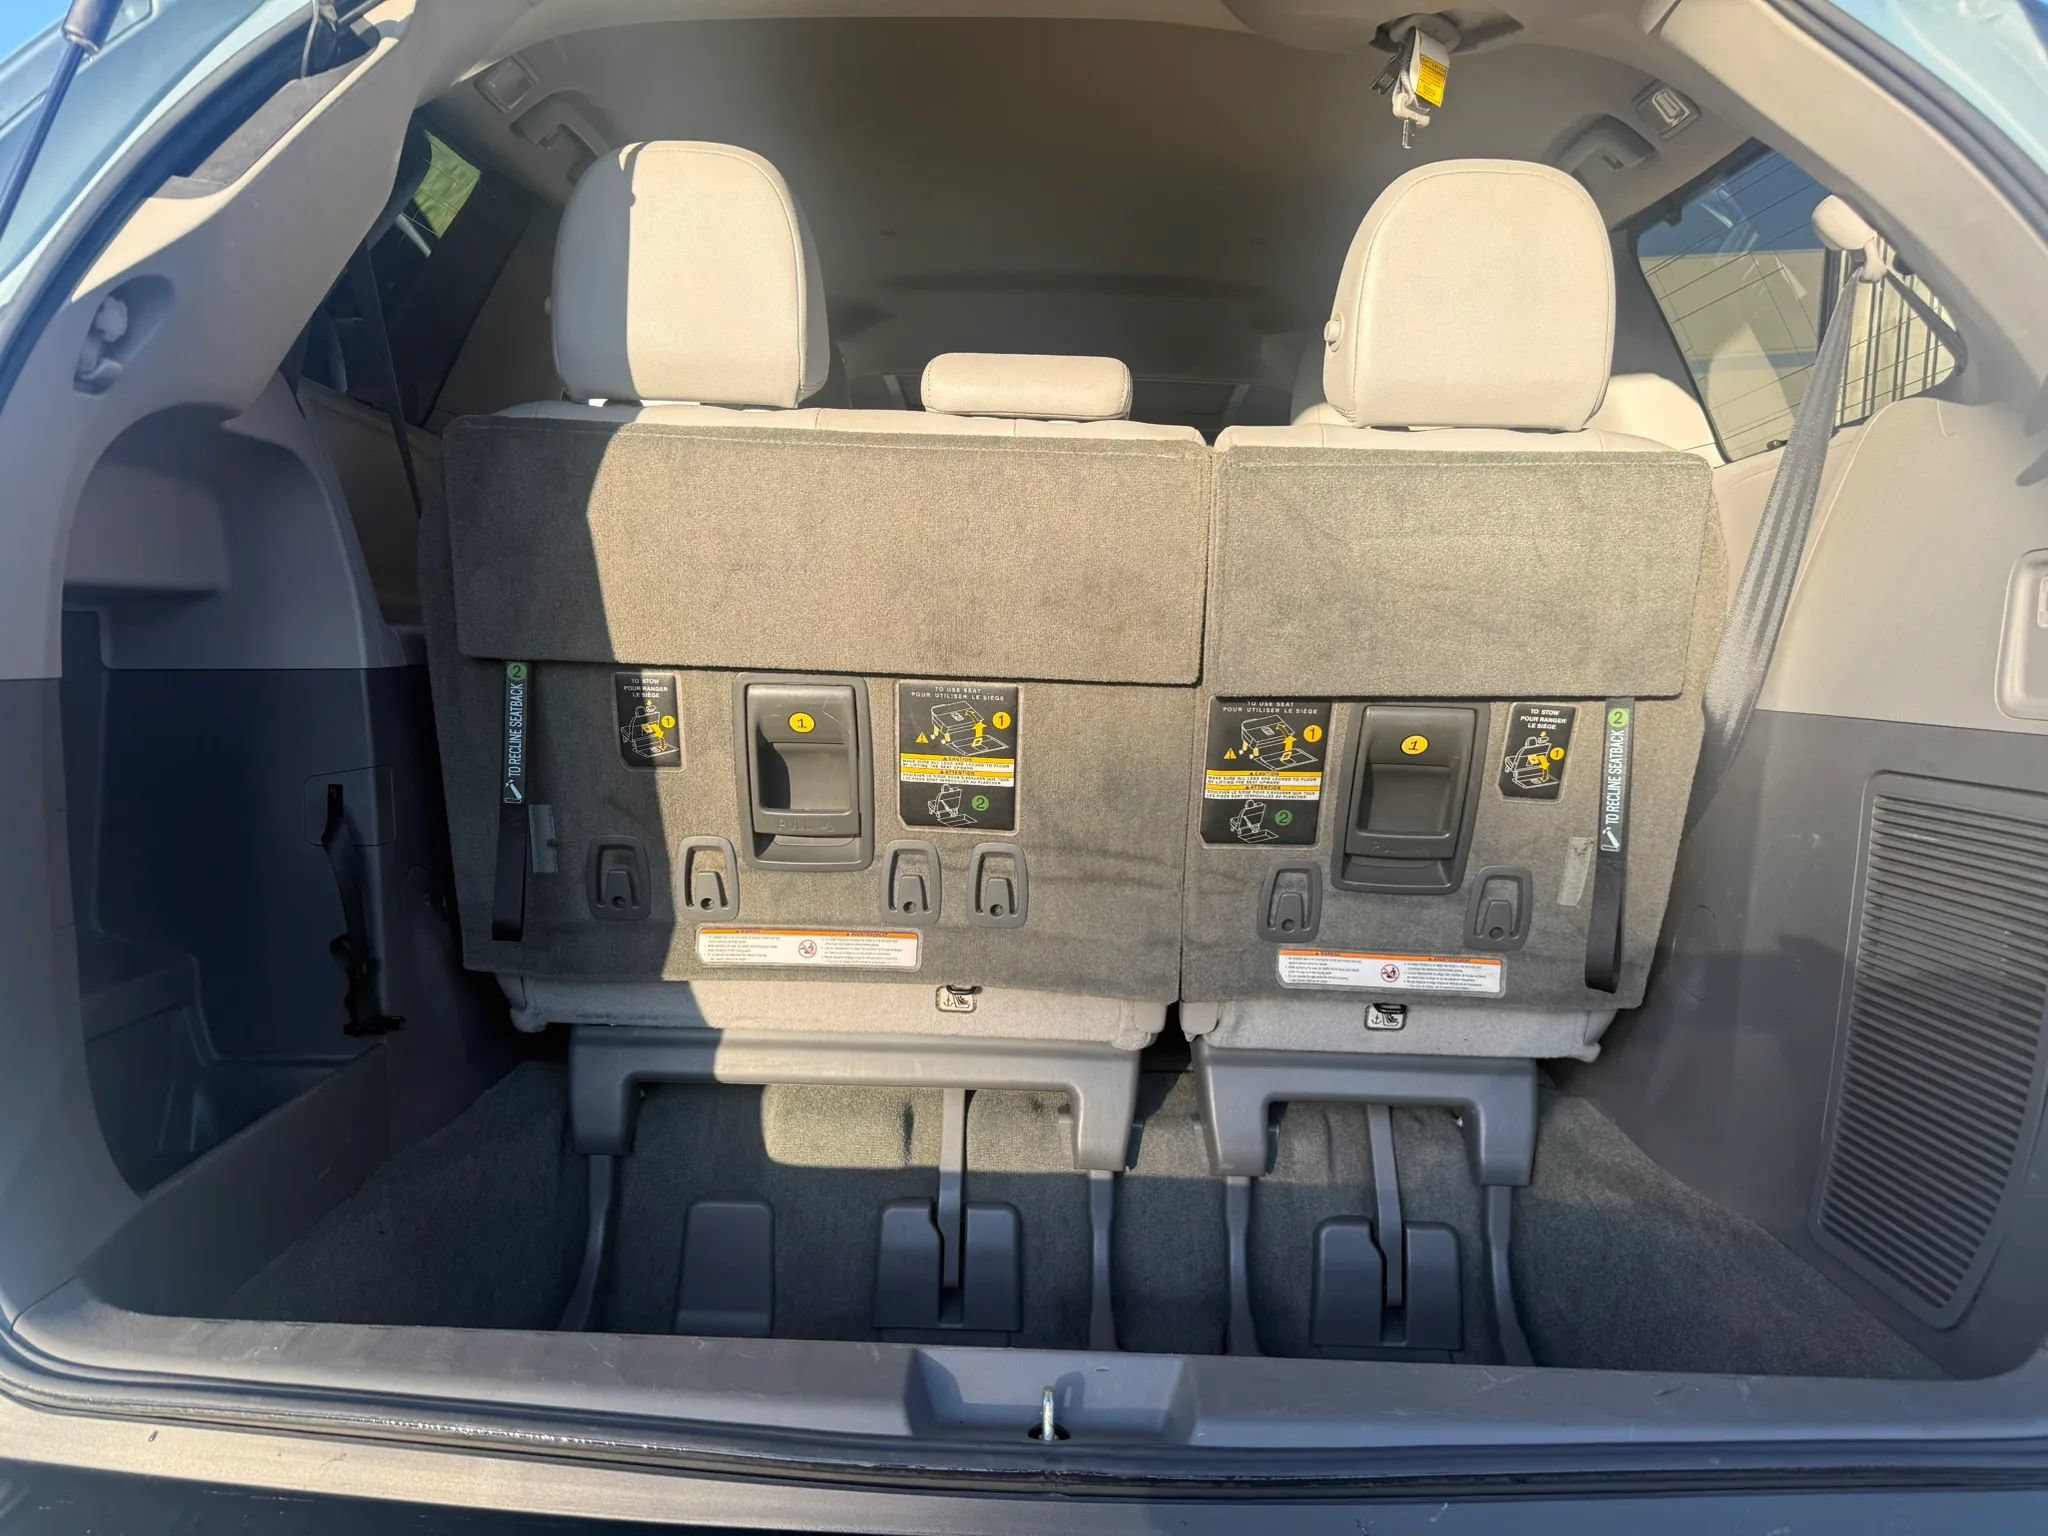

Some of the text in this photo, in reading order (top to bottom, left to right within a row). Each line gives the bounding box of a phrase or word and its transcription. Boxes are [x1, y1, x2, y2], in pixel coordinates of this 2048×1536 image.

[513, 665, 520, 678] 2
[797, 719, 807, 729] 1
[1613, 712, 1622, 724] 2
[508, 683, 523, 778] TO RECLINE SEATBACK
[1408, 741, 1419, 750] 1
[1606, 730, 1625, 824] TO RECLINE SEATBACK
[976, 798, 984, 809] 2
[1280, 812, 1288, 824] 2
